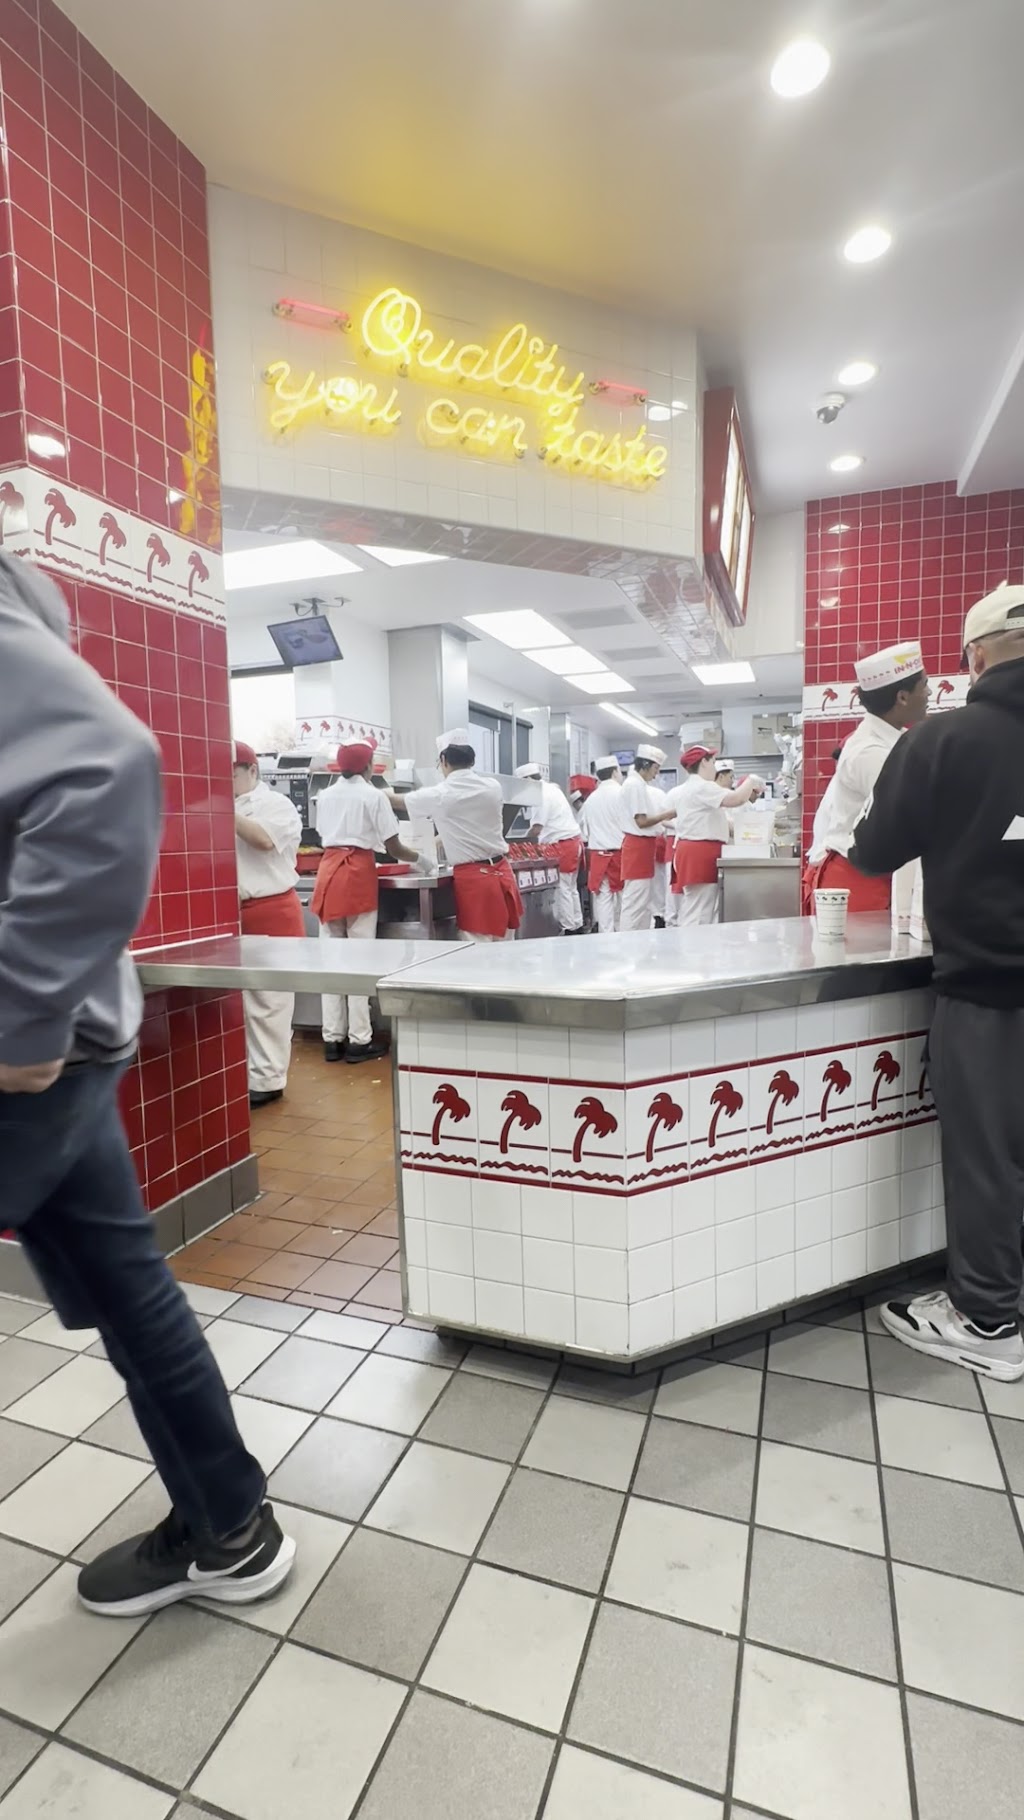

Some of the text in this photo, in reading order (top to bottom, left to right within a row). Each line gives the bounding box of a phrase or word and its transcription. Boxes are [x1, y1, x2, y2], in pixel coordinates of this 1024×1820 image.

[362, 288, 584, 417] Quality
[268, 361, 668, 477] you can taste
